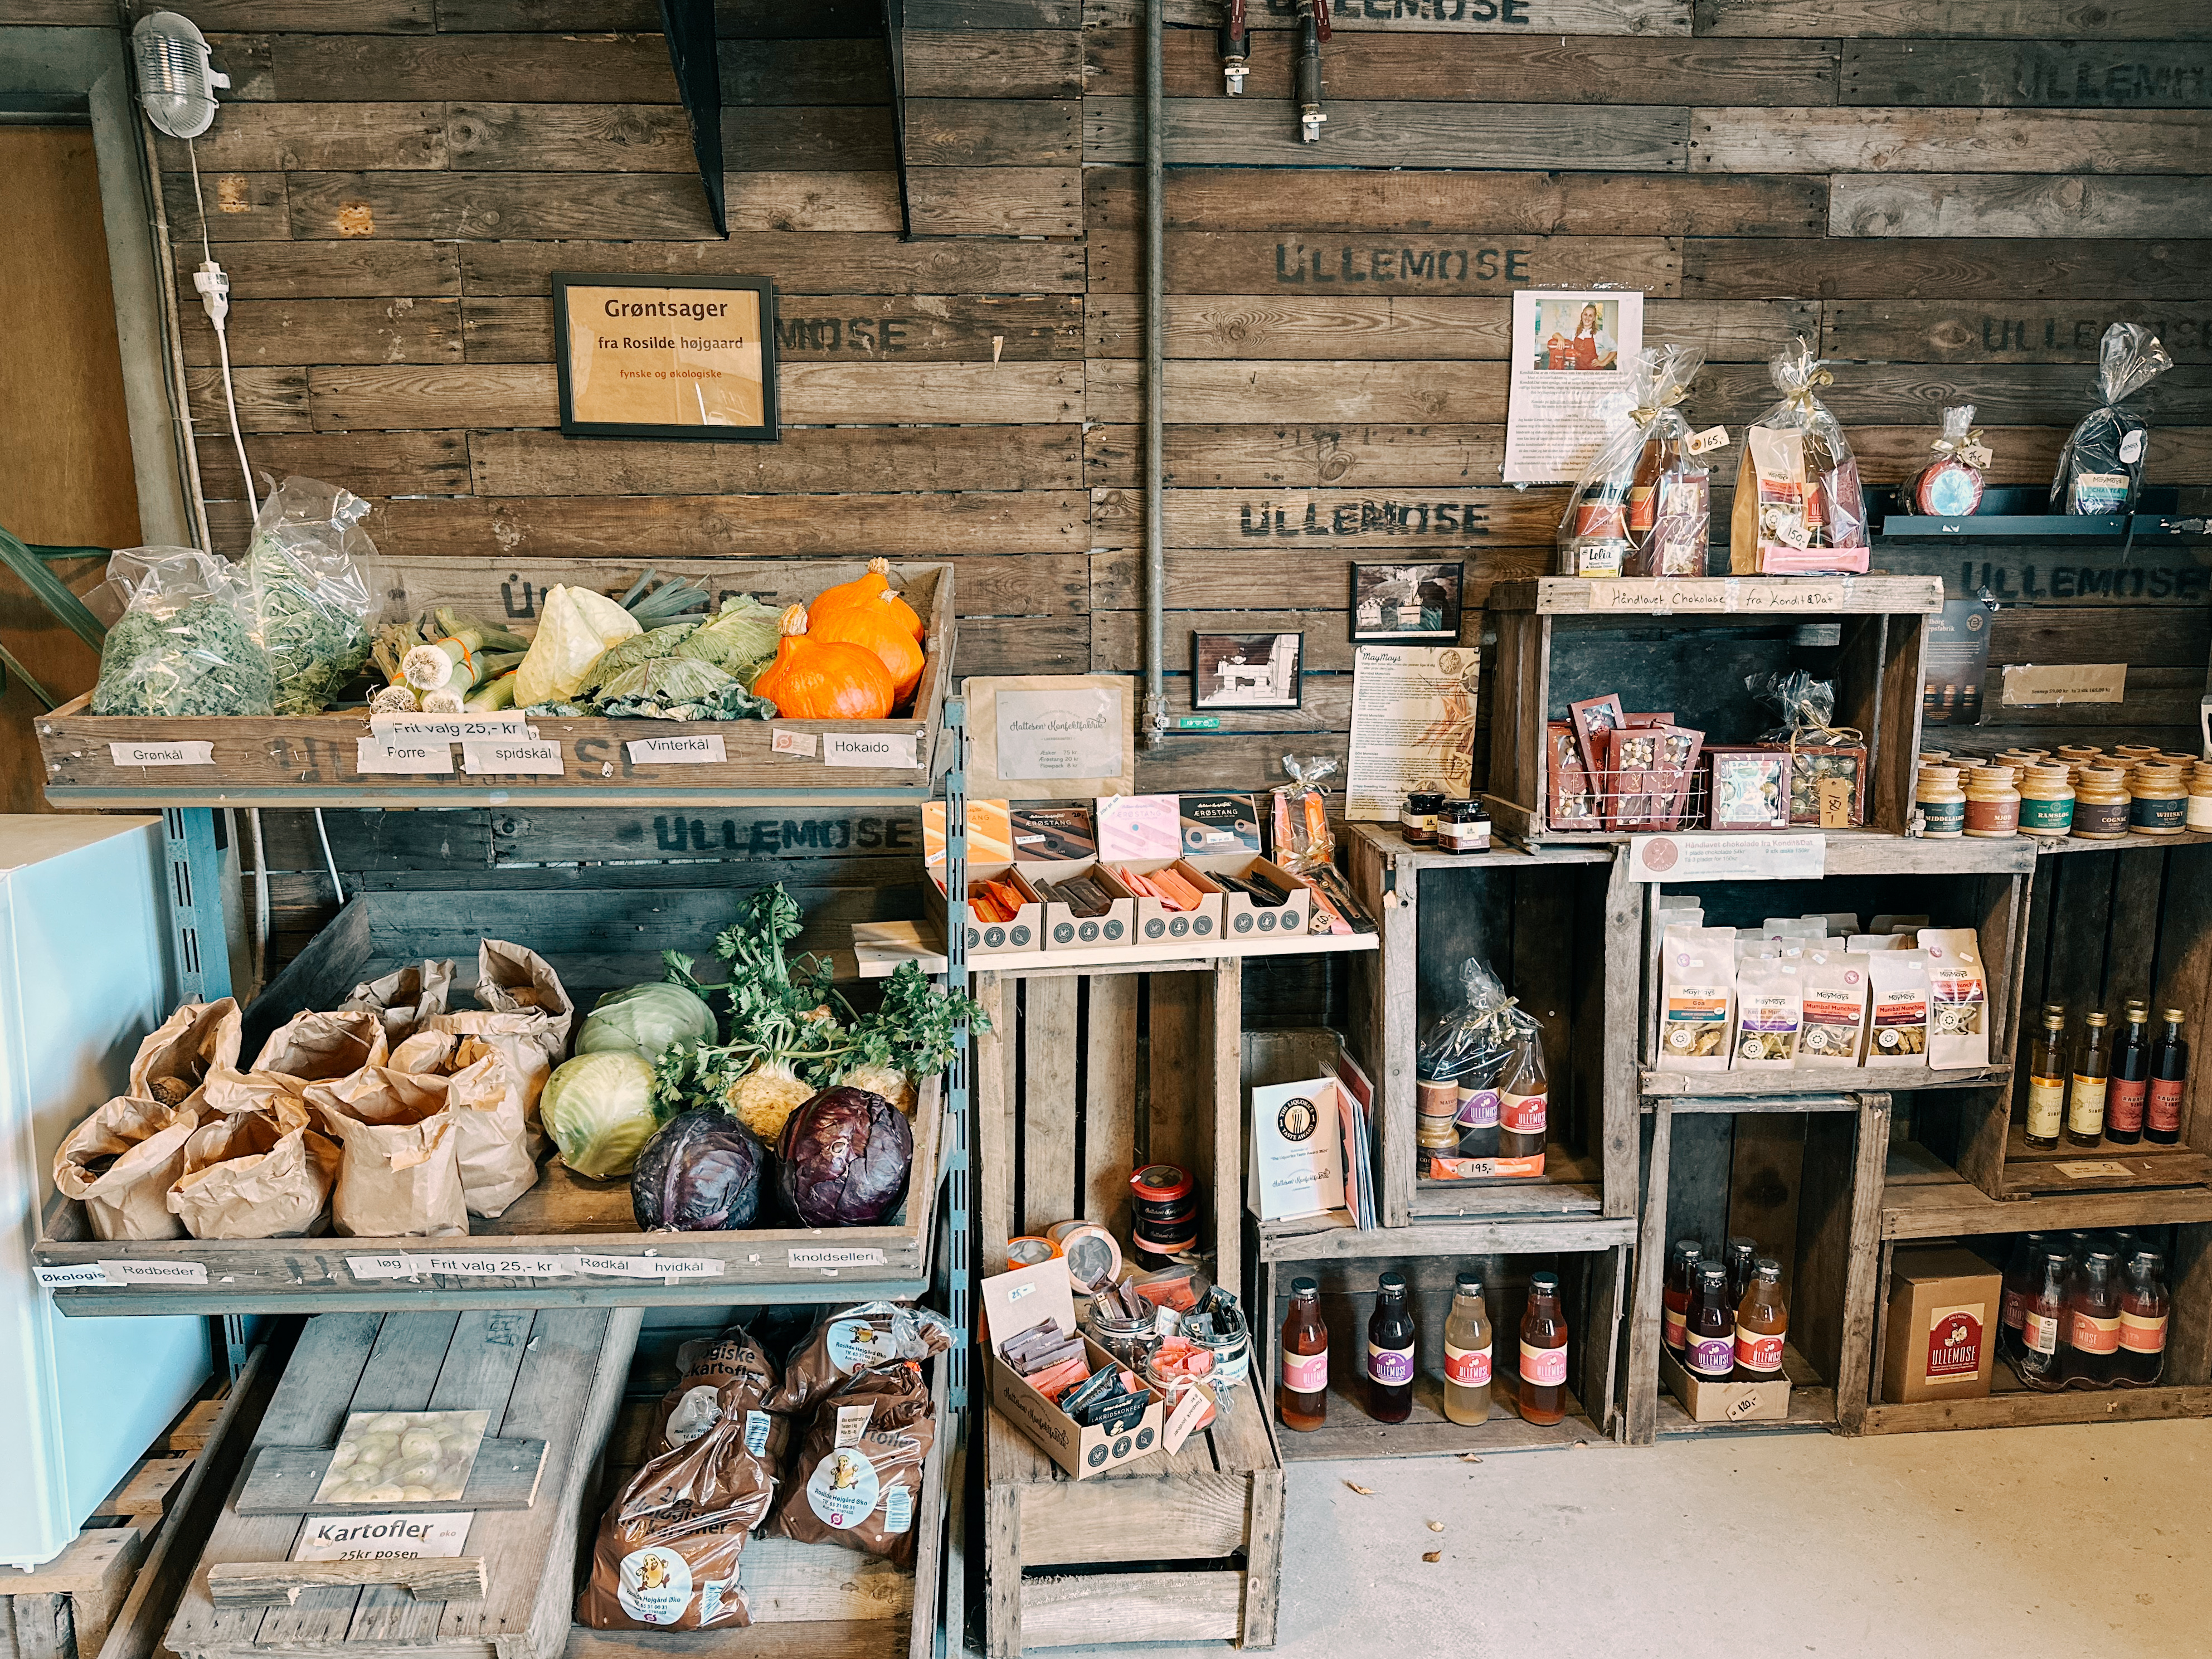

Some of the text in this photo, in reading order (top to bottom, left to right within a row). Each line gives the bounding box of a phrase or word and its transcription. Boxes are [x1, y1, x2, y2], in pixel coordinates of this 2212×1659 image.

[1276, 243, 1531, 283] ULLEMOSE
[604, 299, 728, 322] Grøntsager
[599, 336, 743, 352] fra Rosilde højgaard
[620, 369, 652, 380] fynske
[669, 369, 722, 380] økologiske
[1240, 500, 1490, 537] ULLEMOSE
[1589, 547, 1612, 561] Lelia
[1612, 587, 1665, 606] Håndlavet
[1746, 588, 1762, 605] fra
[1362, 653, 1402, 663] MayMays
[393, 722, 518, 737] Frit valg 25,- kr
[646, 738, 709, 752] Vinterkål
[835, 741, 889, 753] Hokaido
[133, 748, 184, 762] Grønkål
[387, 747, 552, 761] Porre spidskål
[652, 814, 913, 854] ULLEMOSE
[1817, 992, 1849, 1000] MayMays
[1282, 1124, 1314, 1140] TASTE AWARD
[1471, 1163, 1492, 1174] 195,-
[377, 1257, 401, 1269] løg
[430, 1257, 457, 1269] Frit
[460, 1257, 495, 1273] valg
[500, 1258, 533, 1273] 25,-
[537, 1258, 555, 1271] kr
[580, 1257, 629, 1270] Rødkål
[654, 1260, 704, 1272] hvidkål
[793, 1250, 874, 1263] knoldselleri
[41, 1264, 195, 1282] Økologis Rødbeder
[856, 1347, 876, 1355] Højgård
[1753, 1350, 1781, 1364] ULLEMOSE
[1932, 1345, 1977, 1365] ULLEMOSE
[1698, 1352, 1729, 1365] ULLEMOSE
[1377, 1363, 1406, 1377] ULLEMOSE
[1459, 1364, 1489, 1378] ULLEMOSE
[1091, 1403, 1145, 1423] LAKRIDSKONFEKT
[815, 1488, 832, 1500] Rosilde
[833, 1495, 855, 1504] Højgård
[318, 1519, 456, 1543] Kartofler øko
[339, 1549, 419, 1560] 25kr posen
